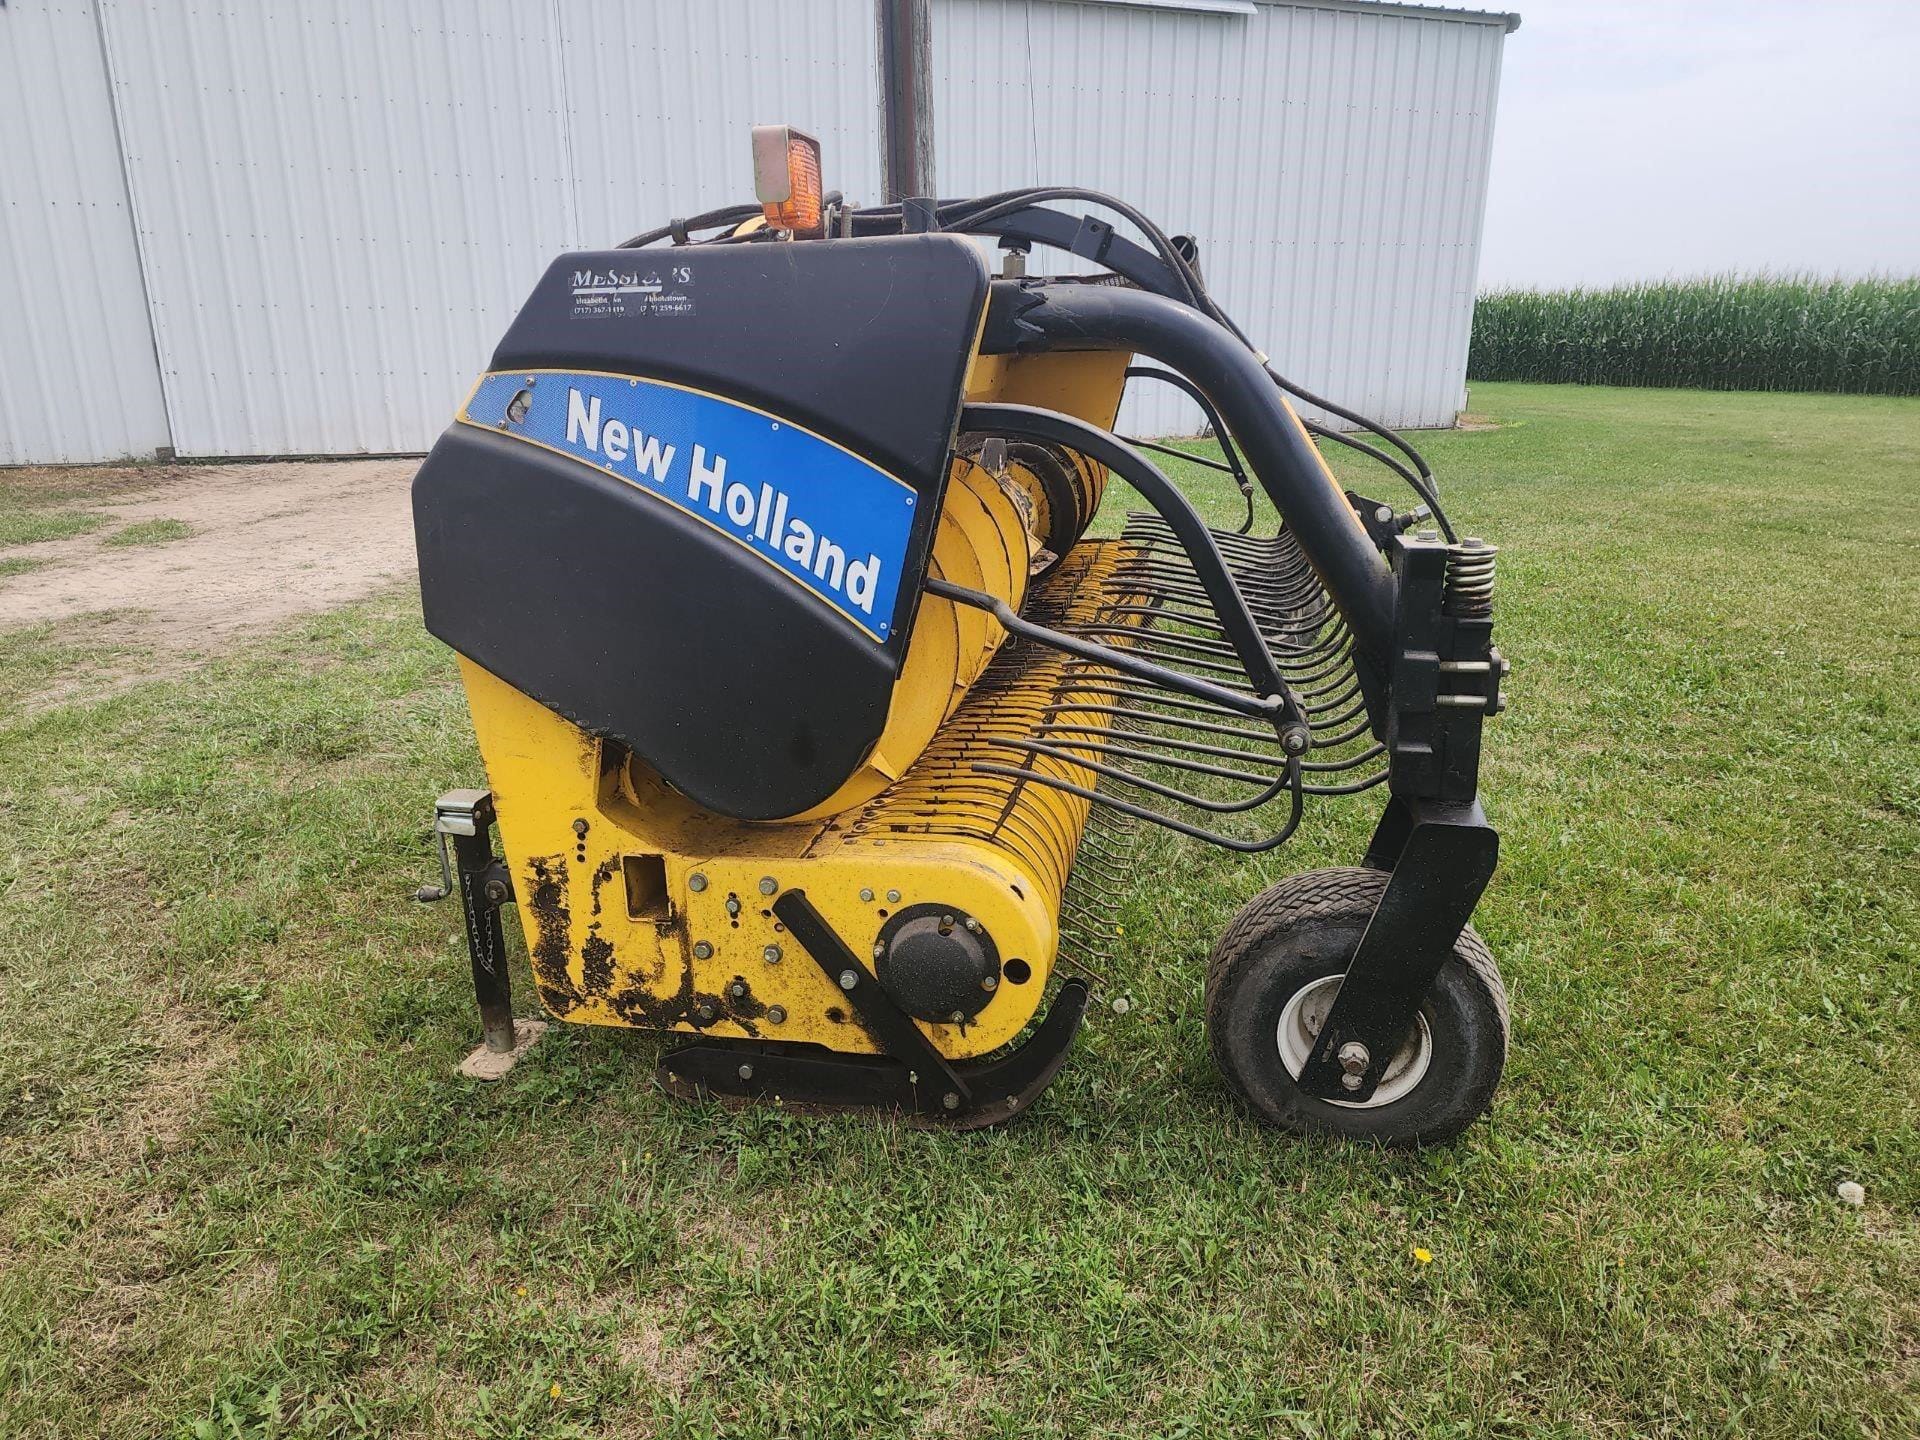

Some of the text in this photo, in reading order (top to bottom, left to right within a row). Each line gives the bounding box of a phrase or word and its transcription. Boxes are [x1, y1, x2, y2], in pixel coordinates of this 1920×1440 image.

[640, 304, 658, 313] (77)
[566, 387, 881, 615] New Holland
